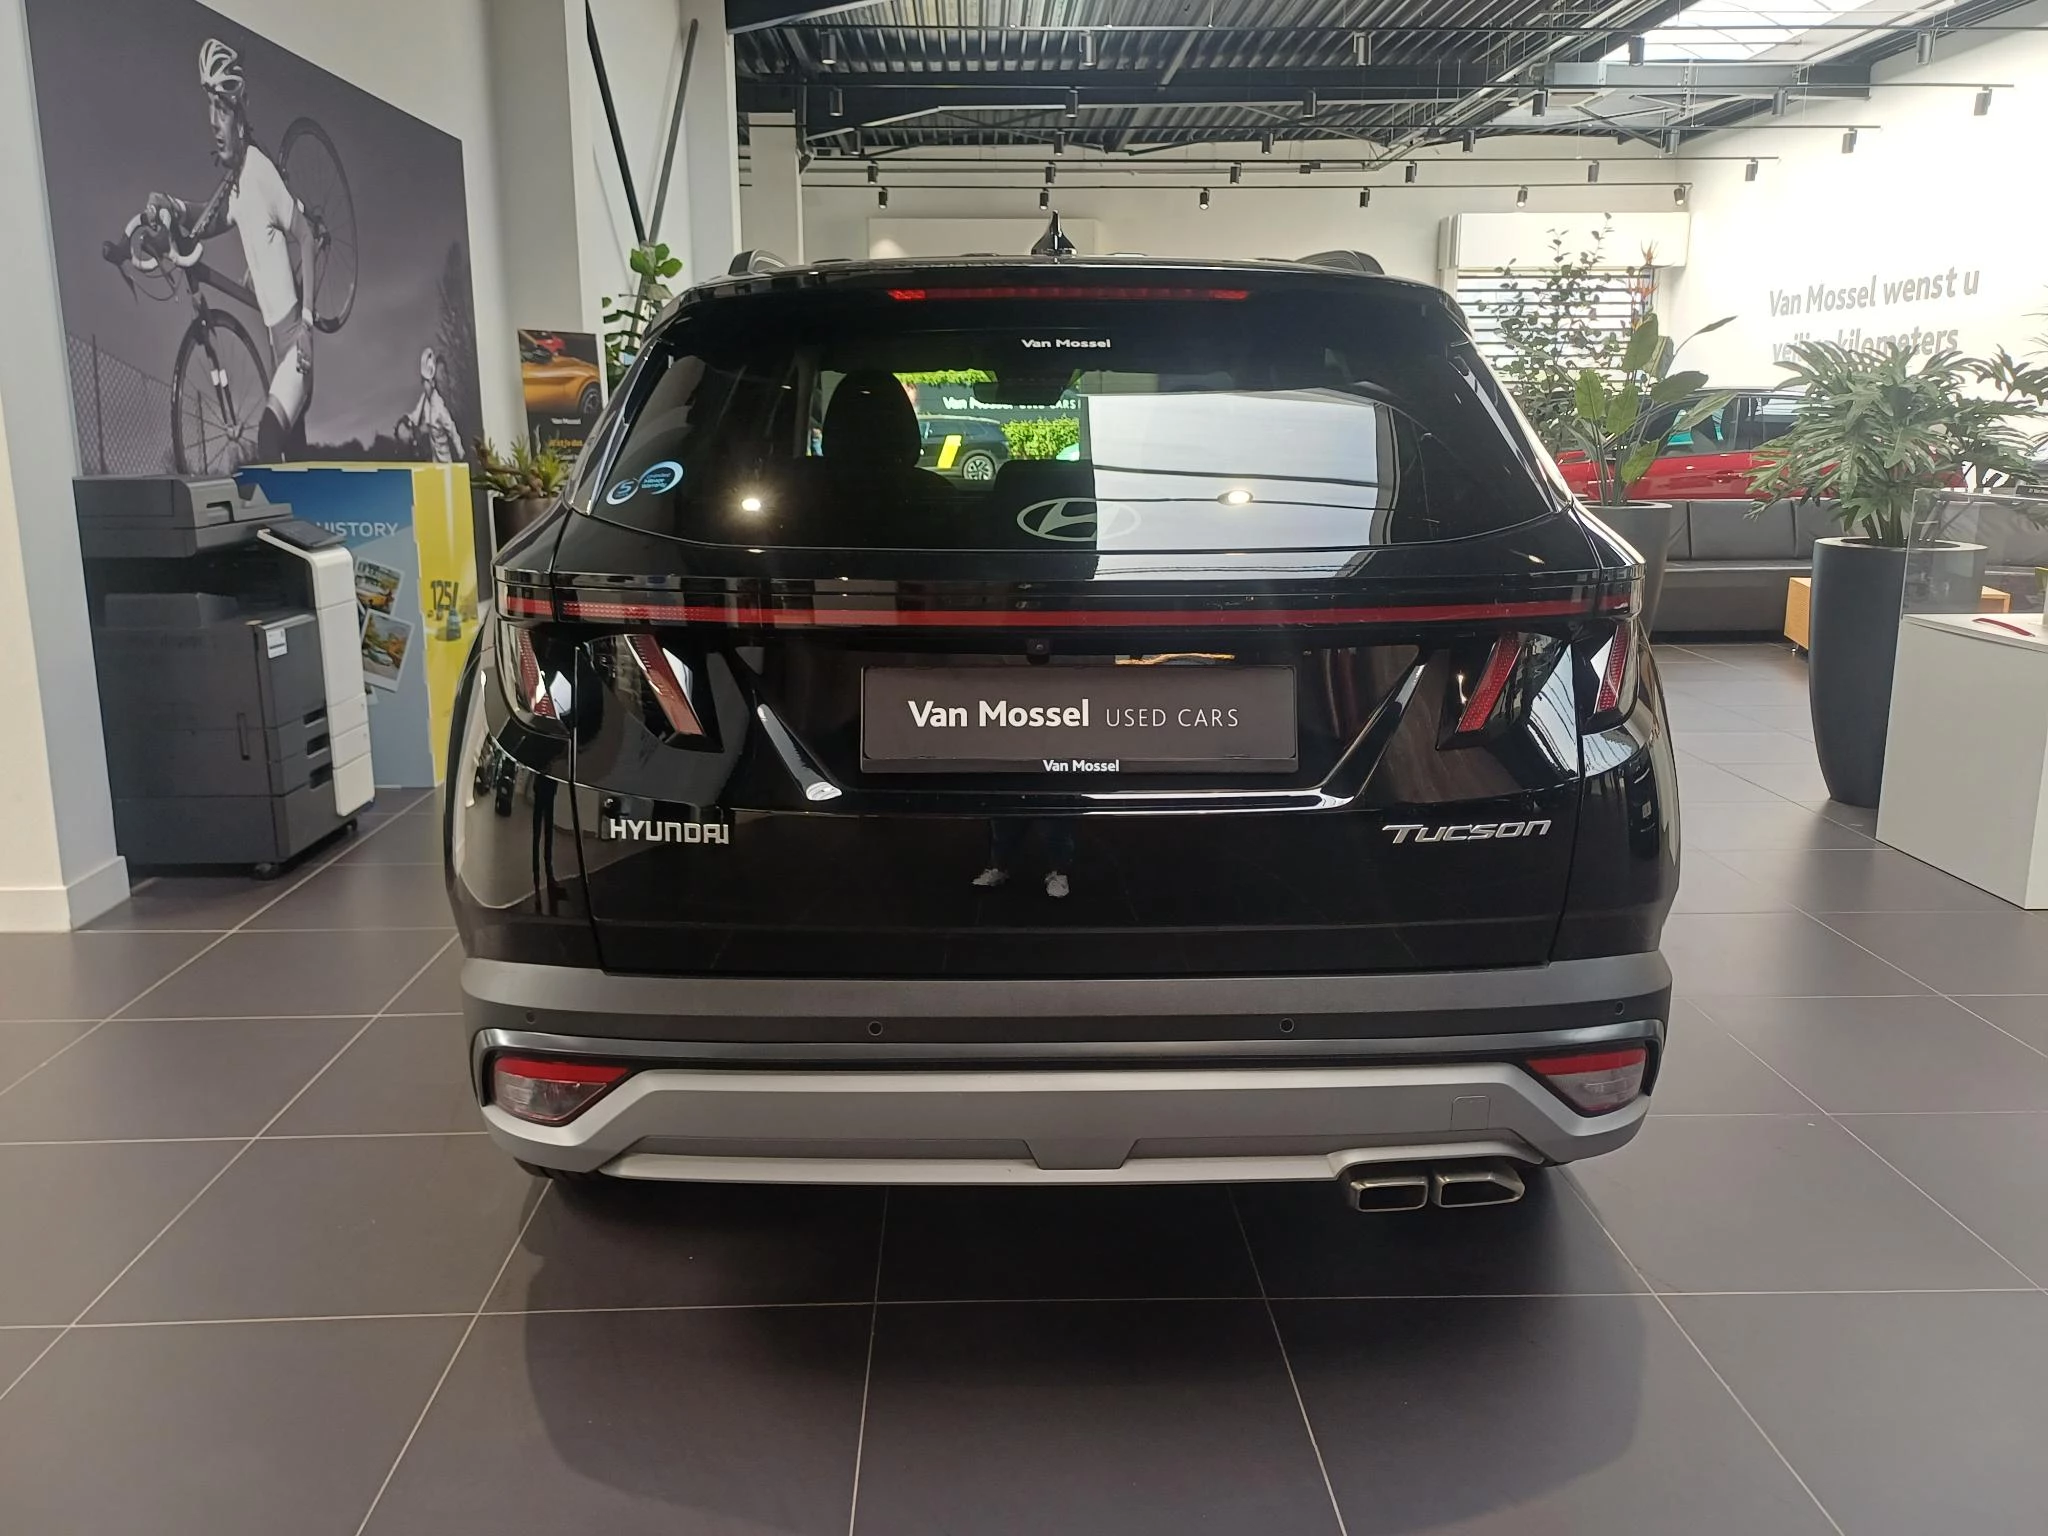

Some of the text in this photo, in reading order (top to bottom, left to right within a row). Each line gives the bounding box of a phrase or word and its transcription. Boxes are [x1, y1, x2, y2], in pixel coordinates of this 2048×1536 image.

[1769, 266, 1980, 318] Van Mossel wenst u
[1020, 338, 1111, 349] Van Mossel
[908, 699, 1239, 728] Van Mossel USED CARS
[1043, 759, 1120, 773] Van Mossel
[609, 818, 729, 845] HYUNDAI
[1381, 819, 1552, 844] TUCSON
